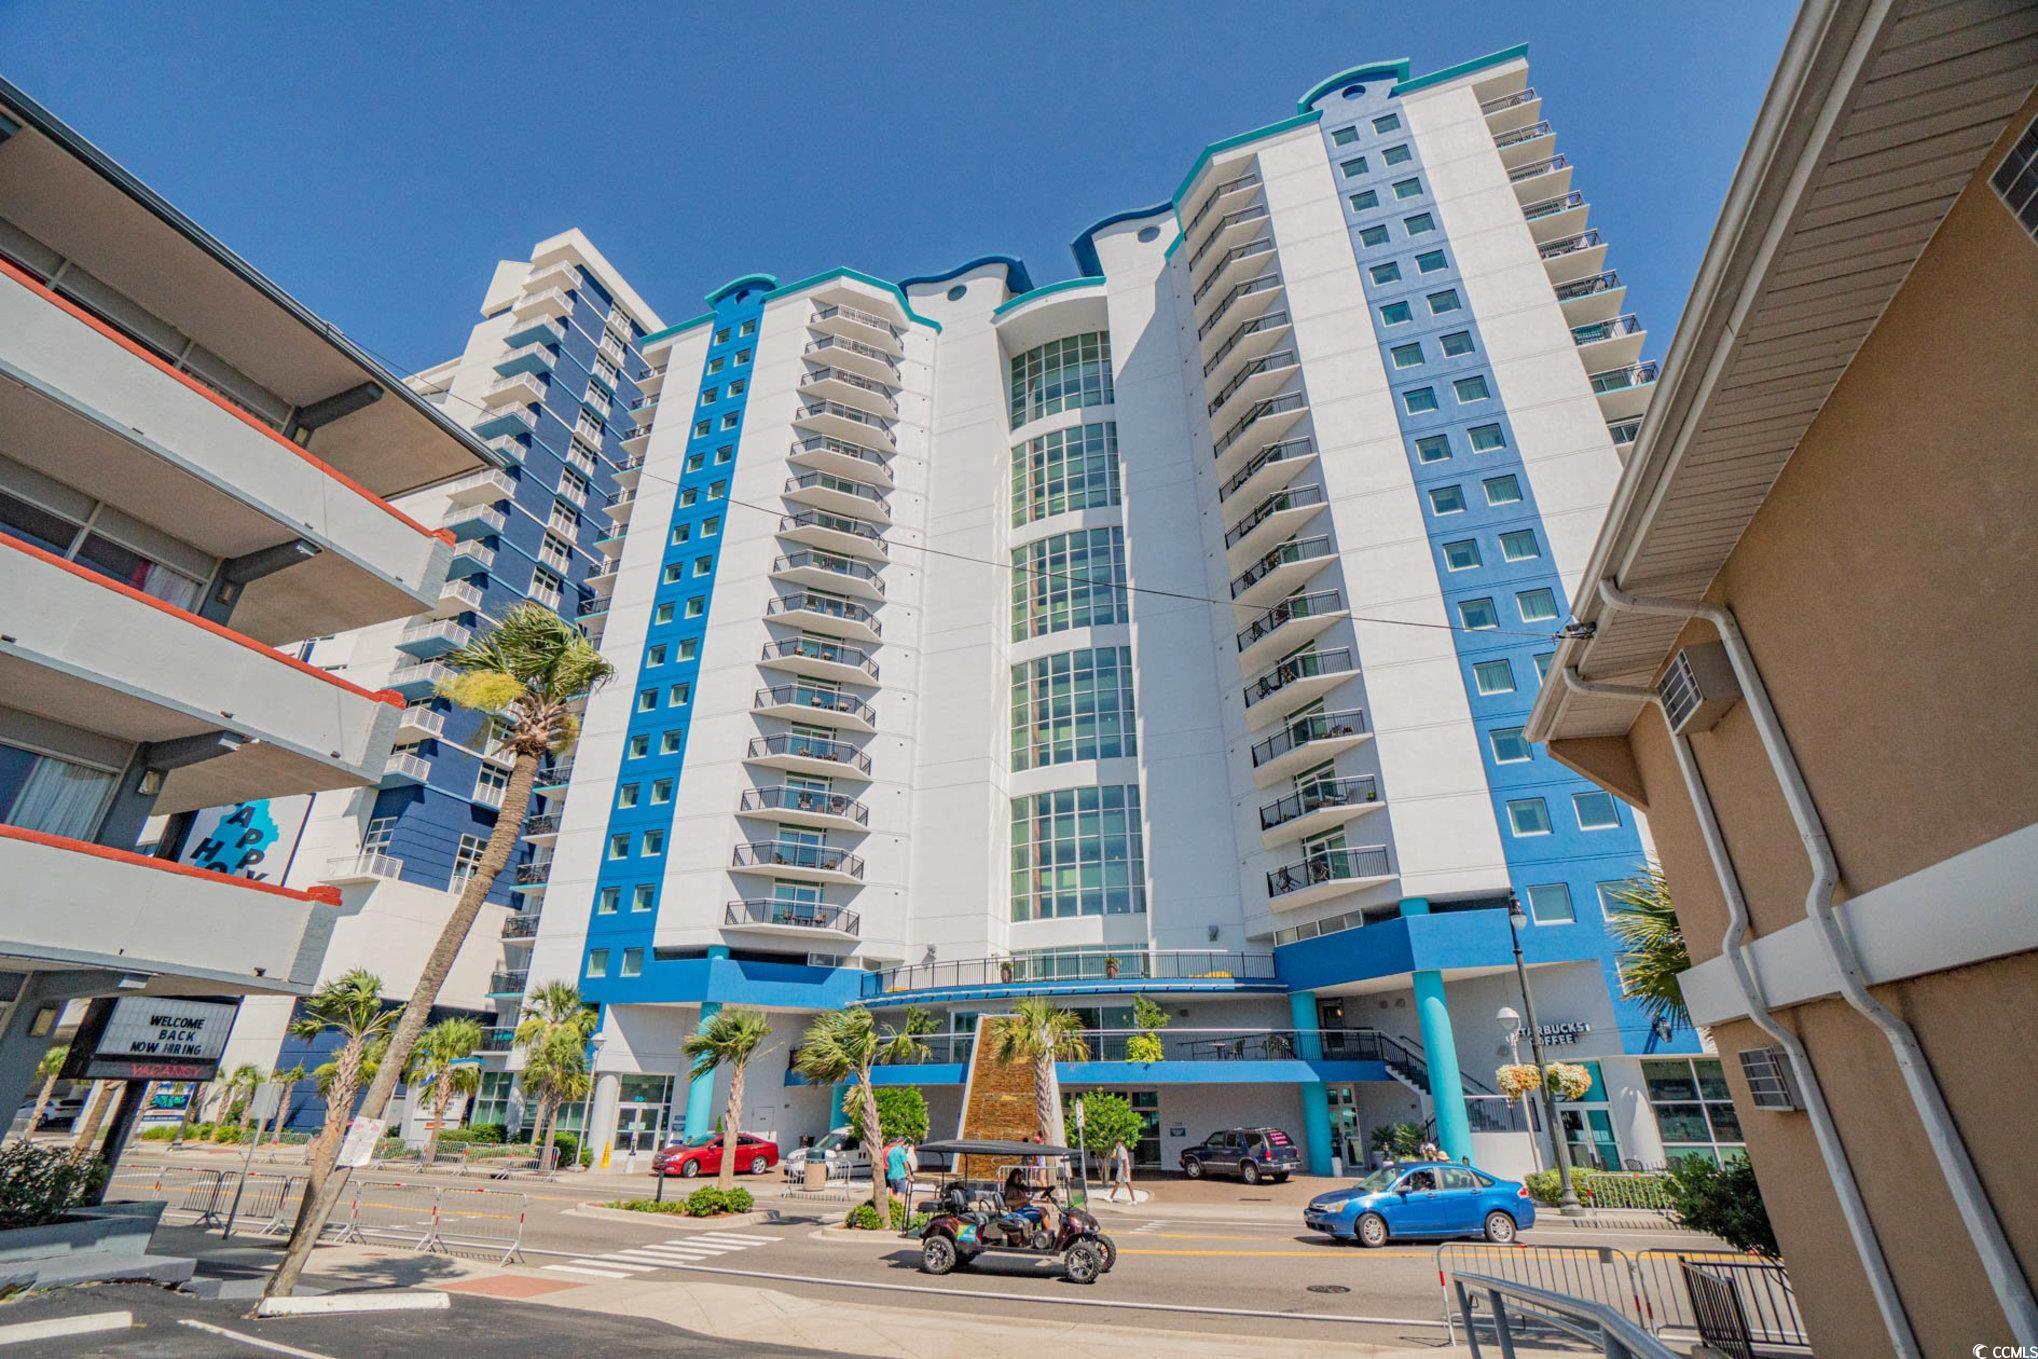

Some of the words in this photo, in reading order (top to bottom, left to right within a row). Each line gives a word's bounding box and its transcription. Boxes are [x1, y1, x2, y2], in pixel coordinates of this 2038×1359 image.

[149, 1014, 205, 1029] WELCOME
[158, 1029, 196, 1042] BACK
[130, 1041, 160, 1053] NOW
[163, 1043, 202, 1055] HIRING
